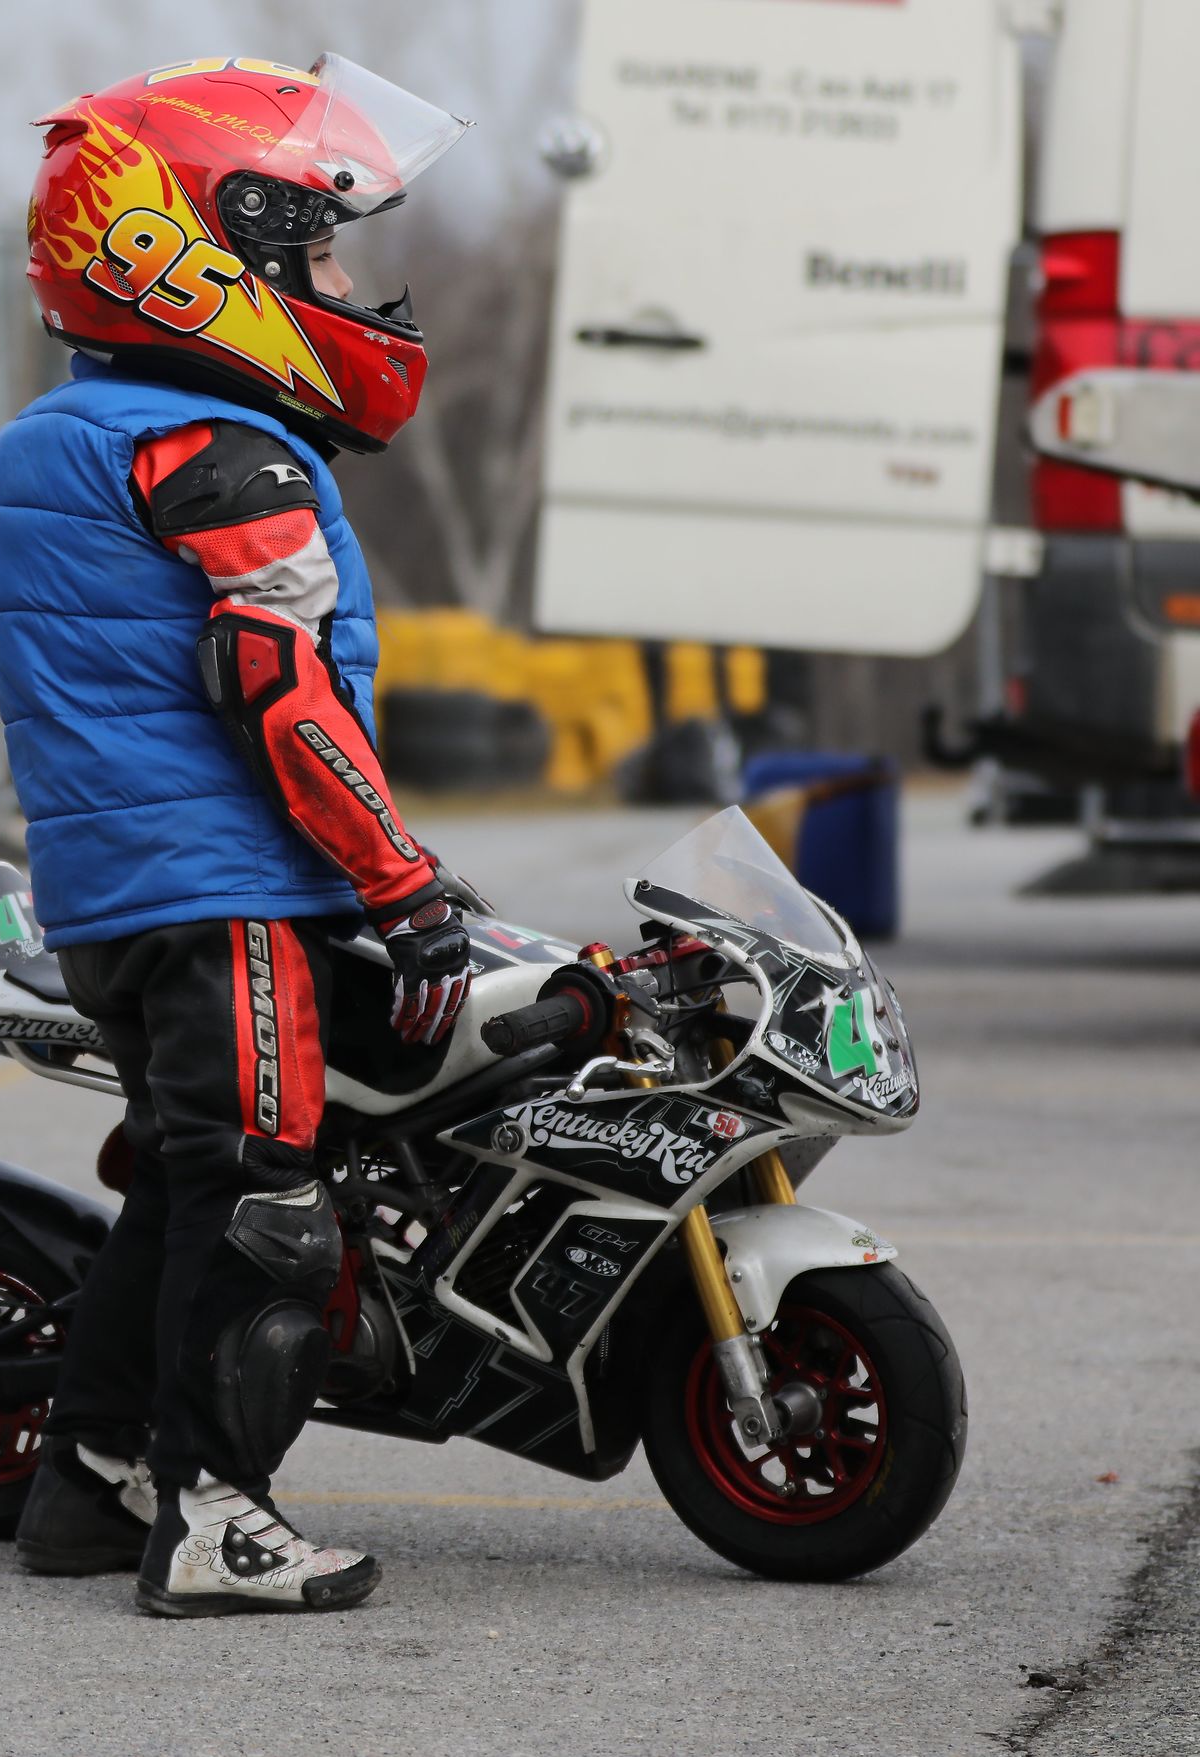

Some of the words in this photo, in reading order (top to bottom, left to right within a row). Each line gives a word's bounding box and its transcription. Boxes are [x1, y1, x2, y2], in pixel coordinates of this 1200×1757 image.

[82, 207, 247, 334] 95
[805, 251, 966, 296] Benelli
[503, 1098, 657, 1159] Kentucky
[647, 1121, 717, 1185] Kid
[714, 1114, 739, 1137] 58
